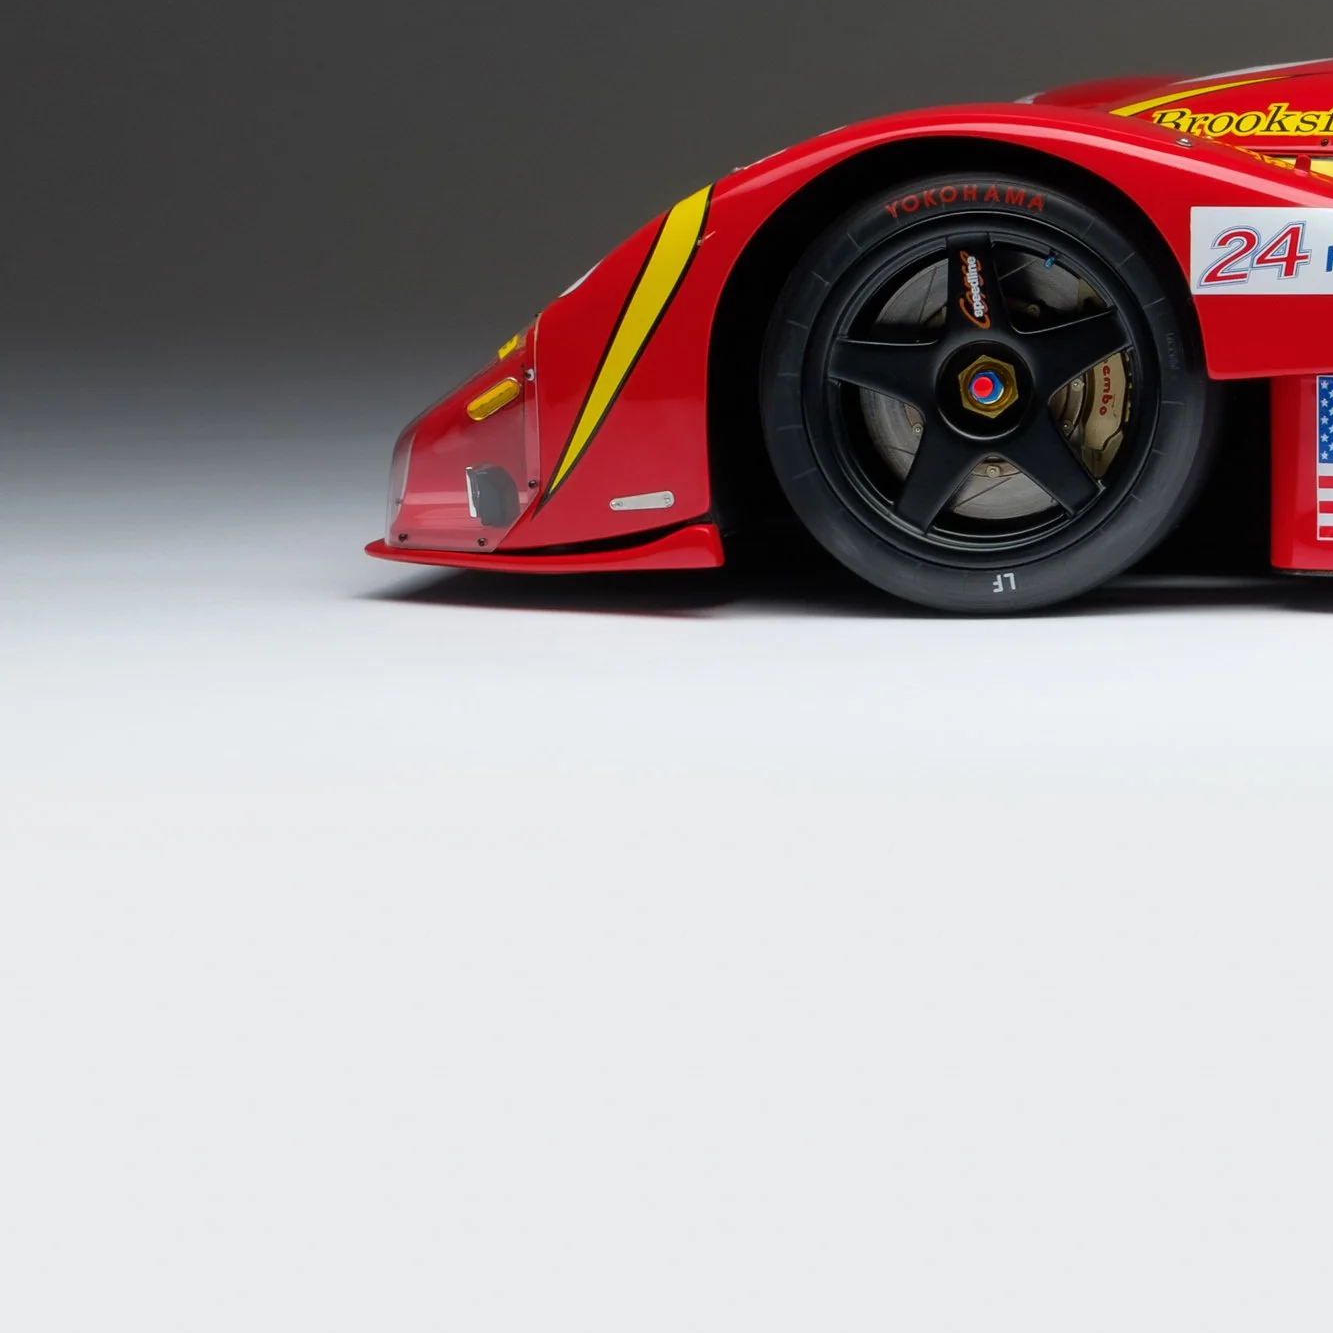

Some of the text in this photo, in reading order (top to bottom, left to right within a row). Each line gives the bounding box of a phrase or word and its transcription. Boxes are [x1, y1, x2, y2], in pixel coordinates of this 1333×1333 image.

[885, 183, 1046, 220] YOKOHAMA
[1197, 221, 1312, 288] 24
[967, 256, 984, 317] speedline
[1099, 359, 1113, 416] embo
[993, 573, 1016, 593] LF
